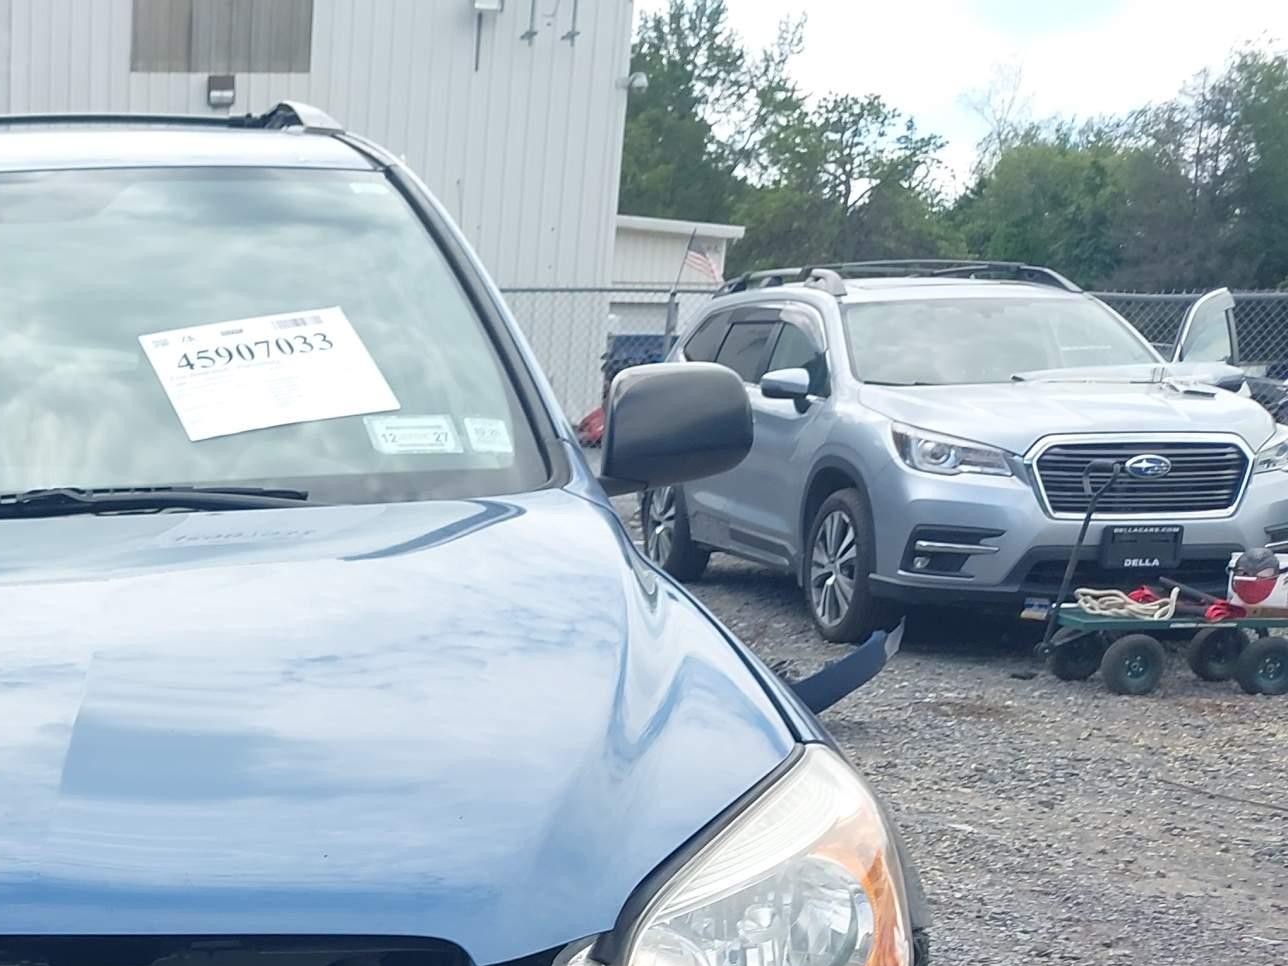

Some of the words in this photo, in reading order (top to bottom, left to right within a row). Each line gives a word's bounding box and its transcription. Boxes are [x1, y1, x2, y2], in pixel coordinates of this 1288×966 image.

[176, 332, 334, 371] 45907033
[381, 433, 398, 444] 12
[1123, 558, 1160, 567] DELLA
